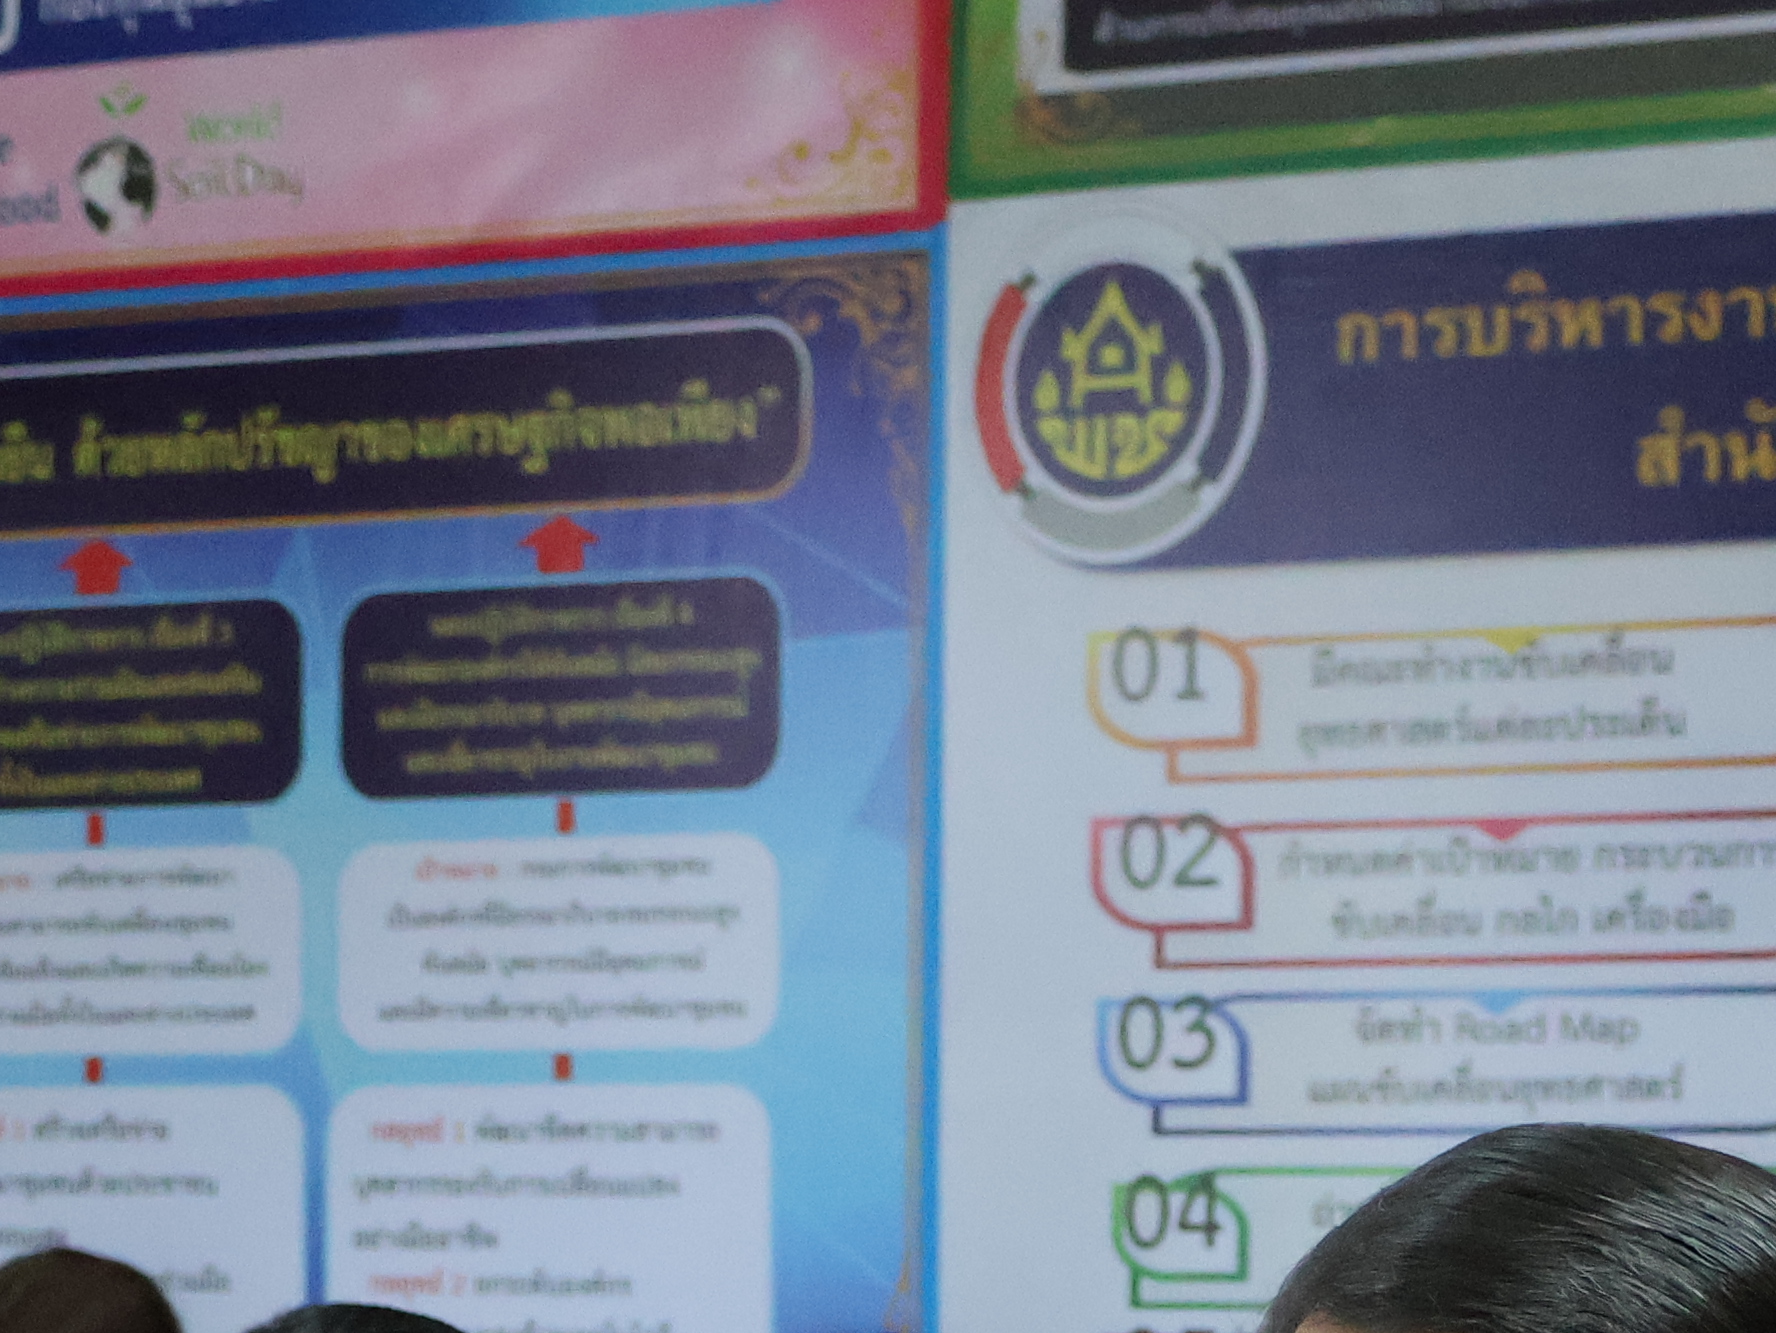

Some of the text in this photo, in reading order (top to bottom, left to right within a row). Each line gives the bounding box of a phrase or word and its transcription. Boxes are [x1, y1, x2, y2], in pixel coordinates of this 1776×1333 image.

[1111, 626, 1209, 703] 01
[1118, 814, 1222, 890] 02
[1117, 994, 1218, 1071] 03
[1454, 1007, 1548, 1046] Road
[1560, 1007, 1641, 1052] Map
[1123, 1174, 1222, 1249] 04
